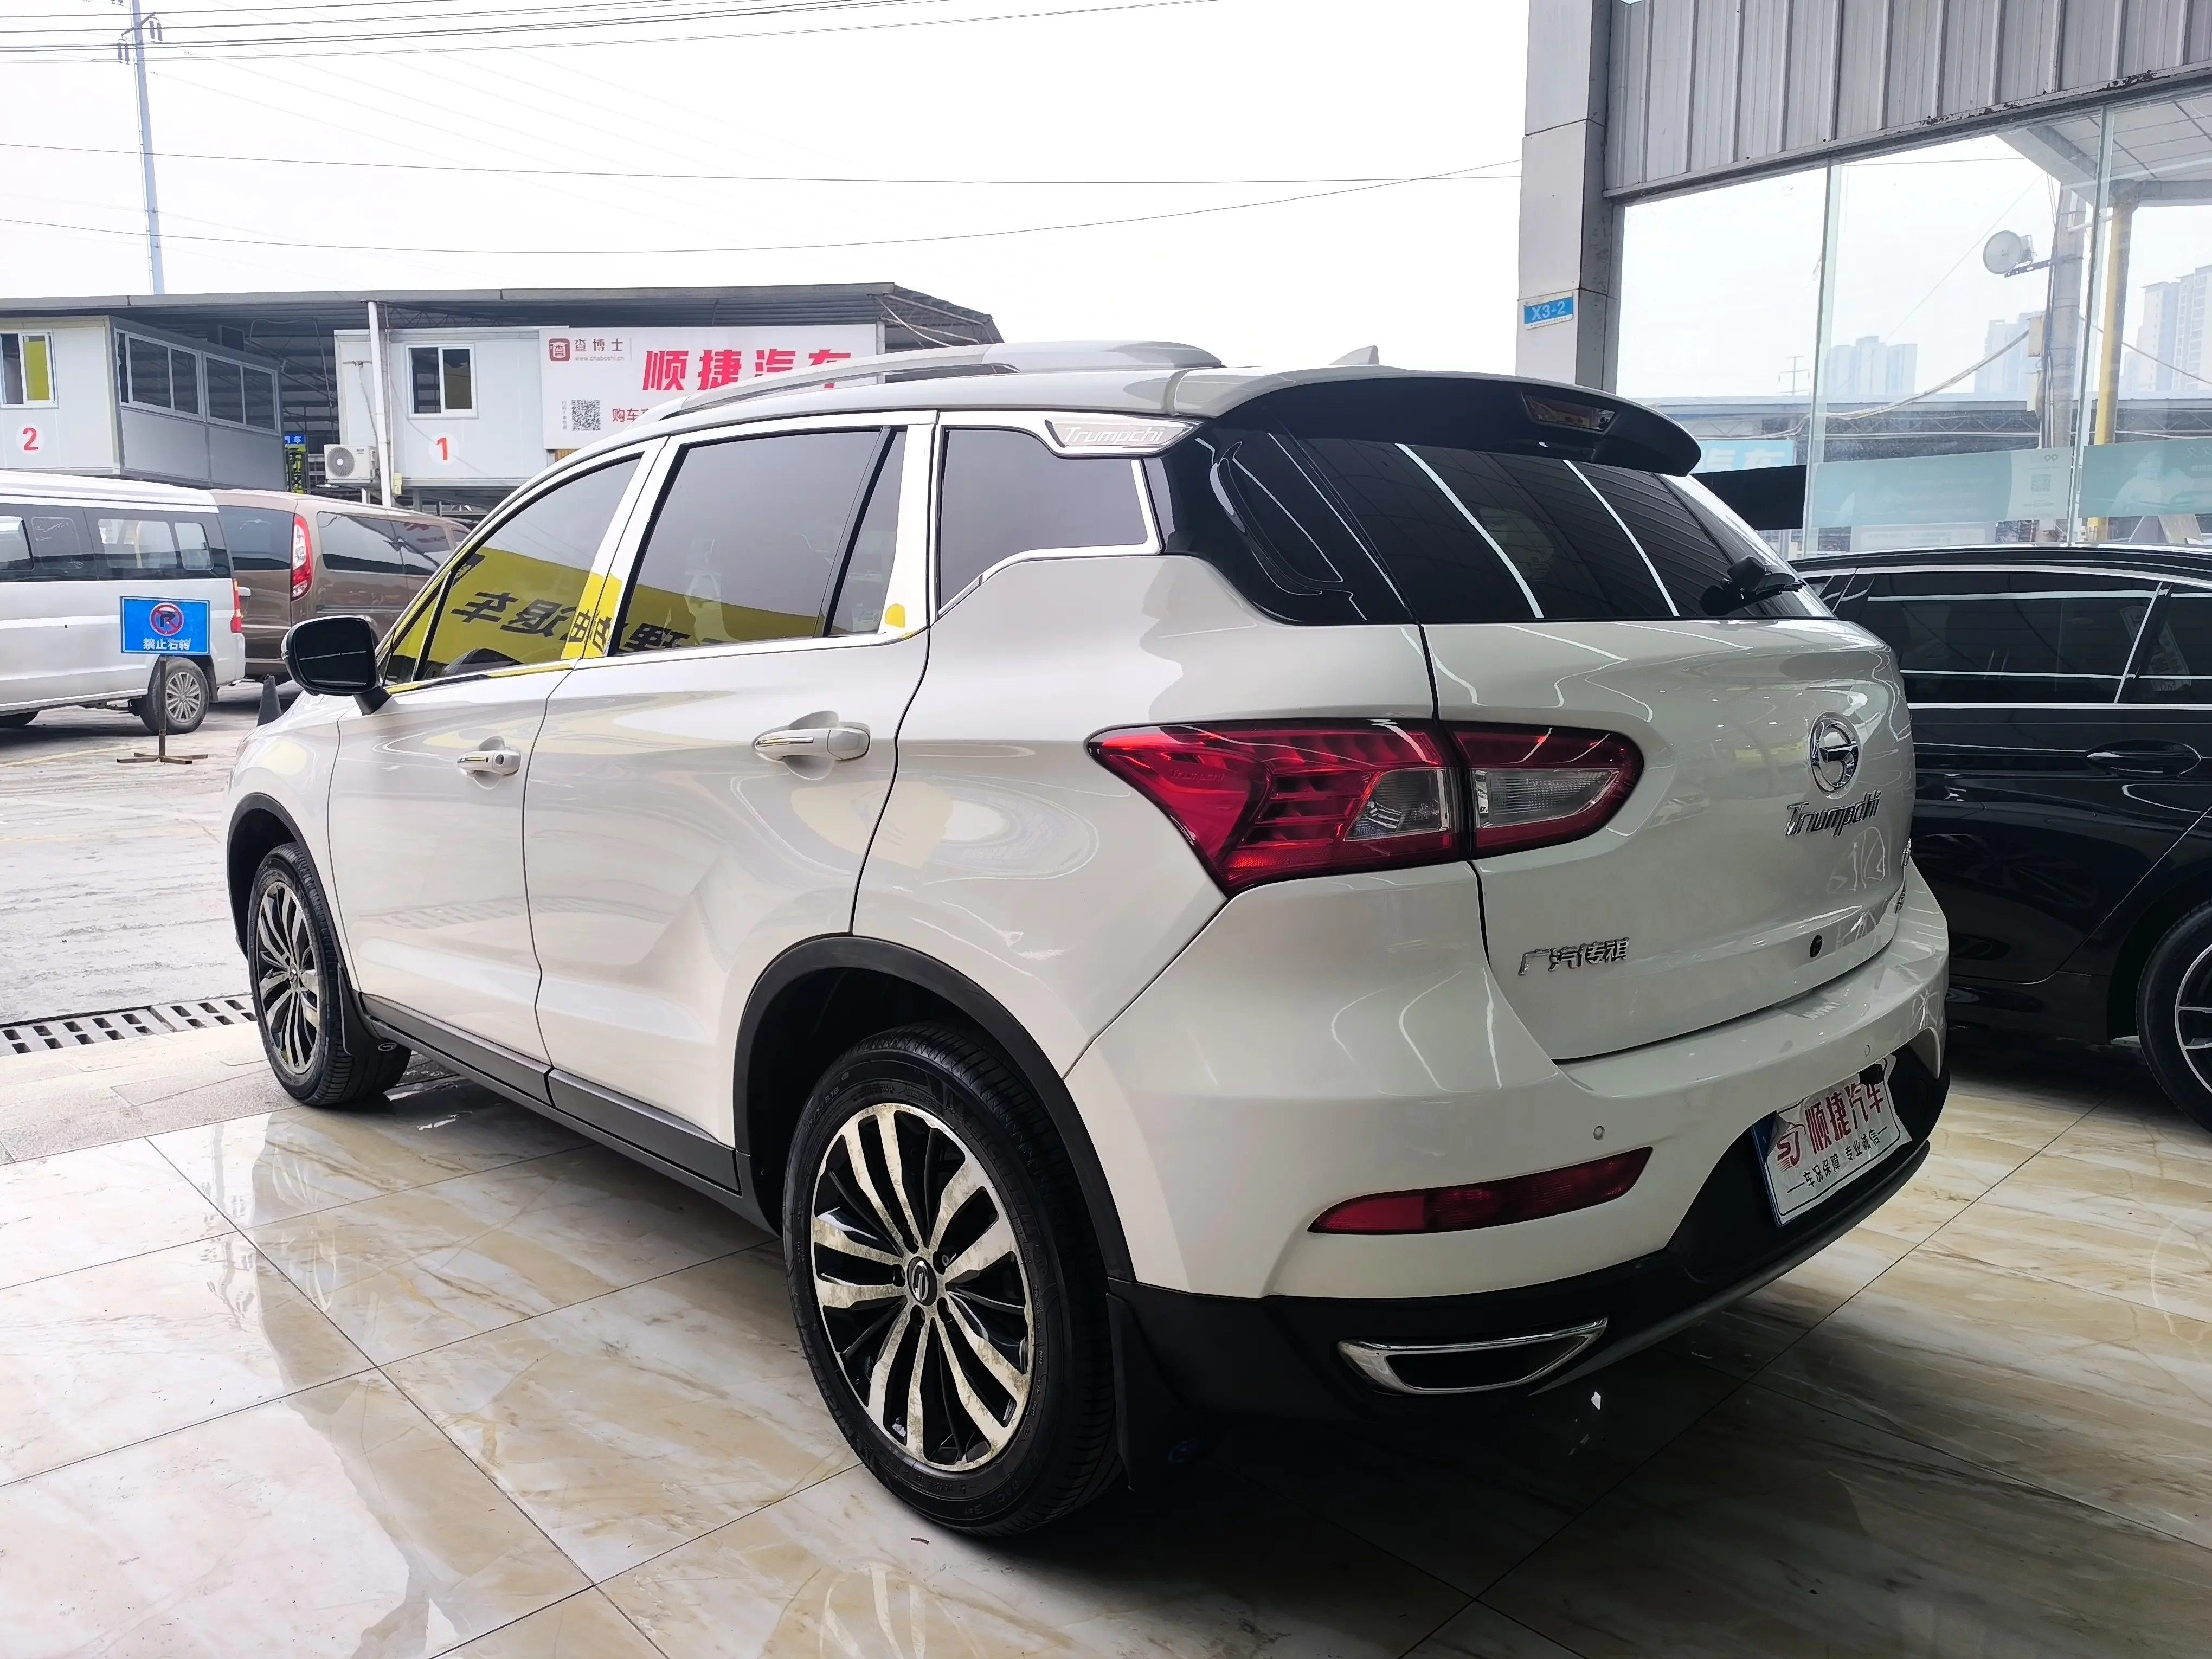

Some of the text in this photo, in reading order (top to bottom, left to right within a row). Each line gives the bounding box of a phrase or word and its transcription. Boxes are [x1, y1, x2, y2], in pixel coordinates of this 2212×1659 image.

[1532, 301, 1565, 320] X3-2
[574, 338, 623, 351] 查博士
[612, 408, 650, 422] 购车
[23, 427, 38, 451] 2
[1064, 427, 1165, 445] Trumpchi
[436, 437, 448, 460] 1
[143, 638, 191, 651] 禁止右转
[1786, 790, 1882, 837] Trumpchi
[1518, 937, 1630, 976] 广汽传祺
[1805, 1083, 1884, 1155] 顺捷汽车
[1803, 1153, 1841, 1187] 车况保障
